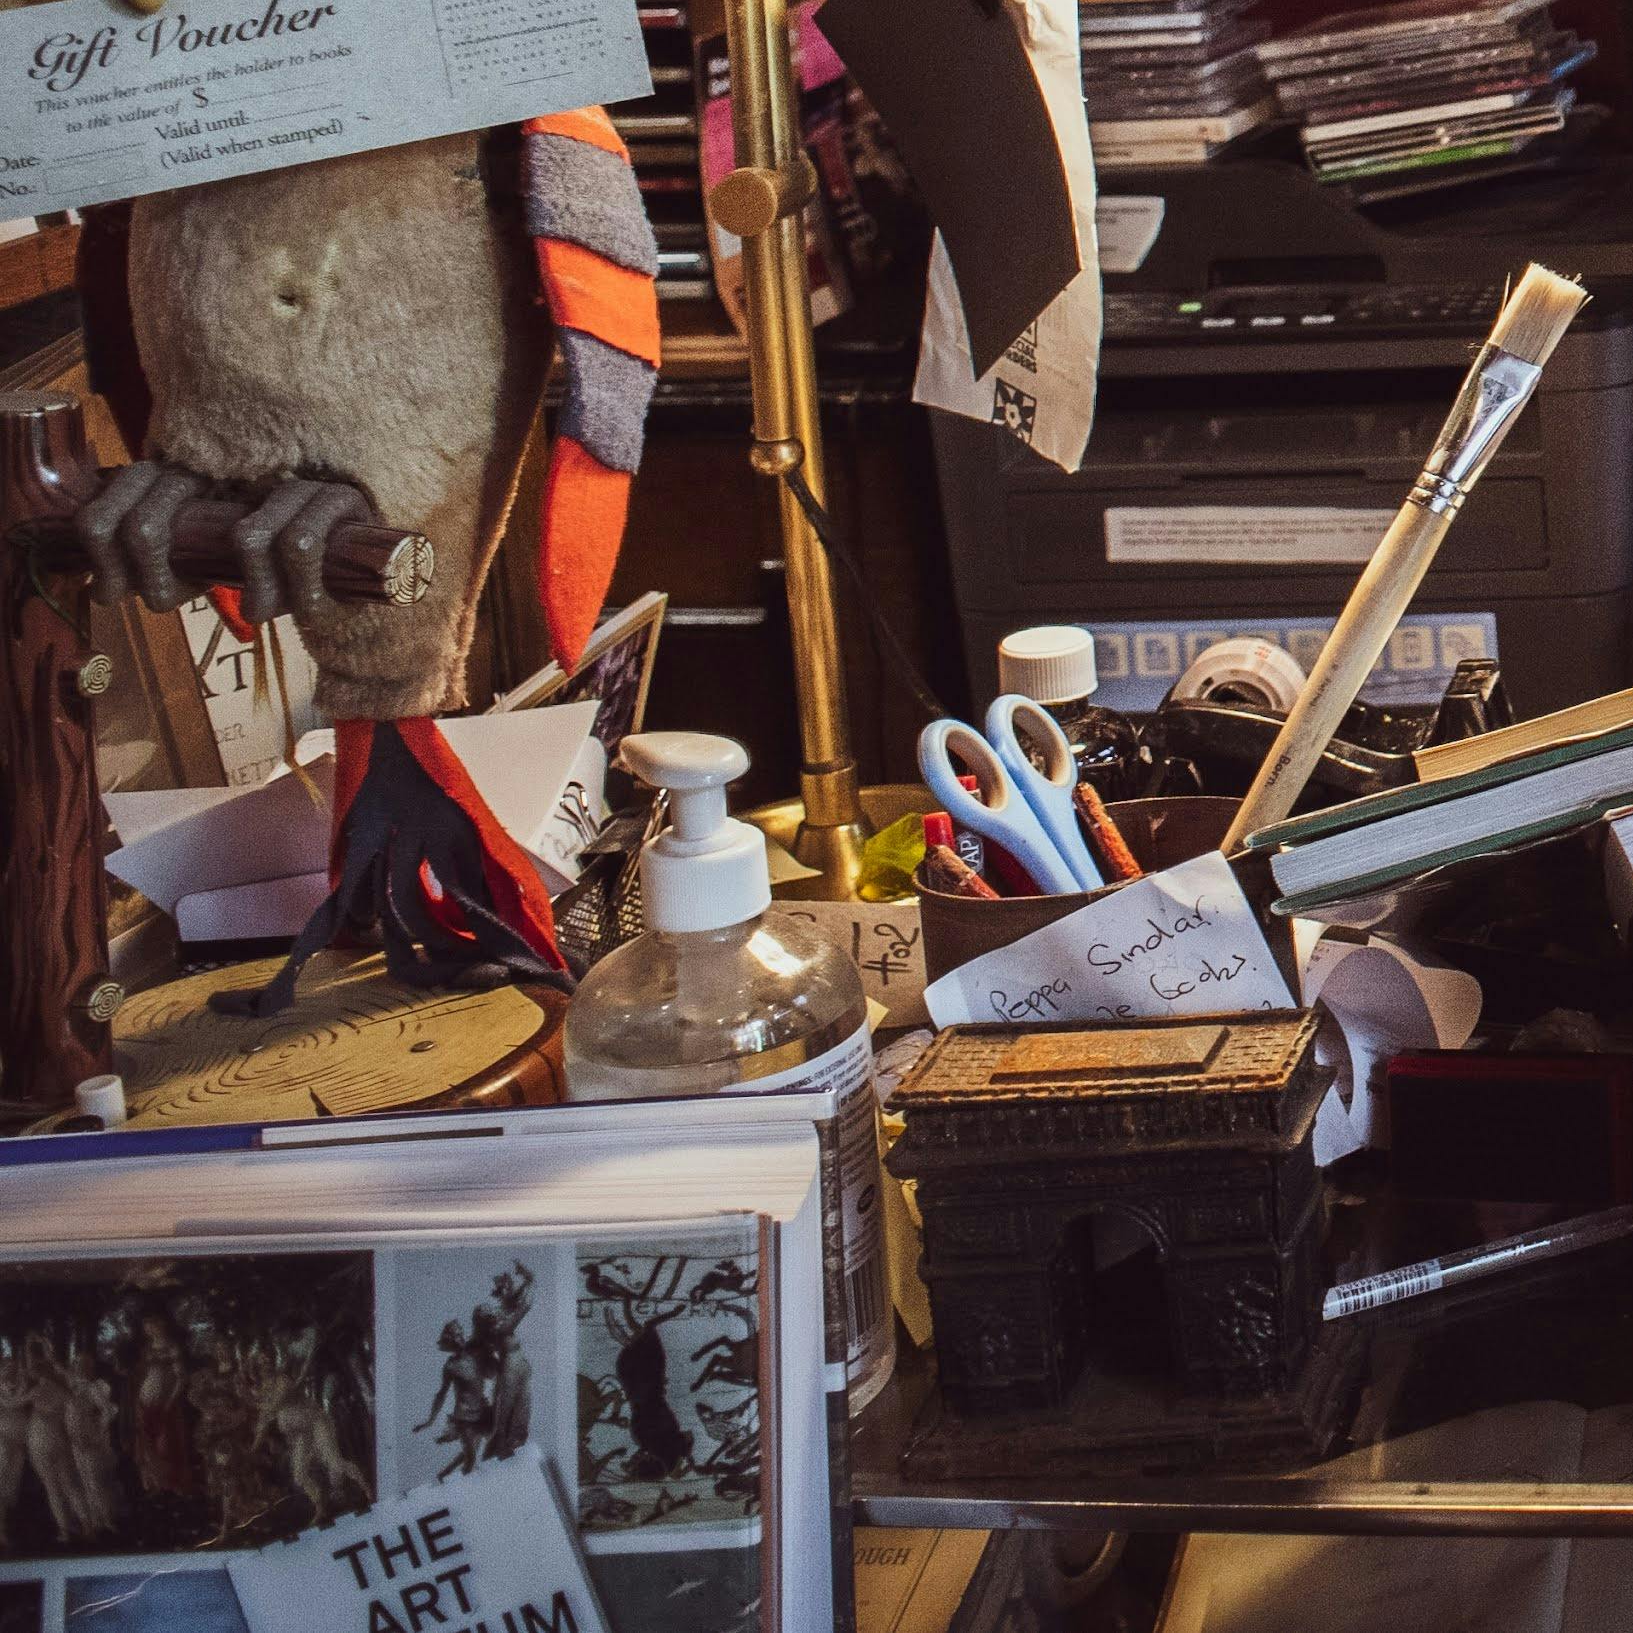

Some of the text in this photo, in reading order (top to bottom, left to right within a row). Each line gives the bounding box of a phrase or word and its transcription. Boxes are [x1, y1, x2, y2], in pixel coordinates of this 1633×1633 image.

[28, 26, 119, 92] Gift
[34, 98, 70, 115] This
[76, 85, 140, 106] voucher
[205, 64, 229, 83] the
[234, 57, 286, 79] holder
[288, 53, 305, 67] to
[308, 43, 353, 61] books
[117, 104, 161, 126] value
[164, 99, 183, 118] of
[192, 86, 210, 111] $
[154, 116, 203, 142] Valid
[160, 119, 345, 170] (Valid when stamped)
[332, 1507, 465, 1591] THE
[368, 1563, 473, 1633] ART
